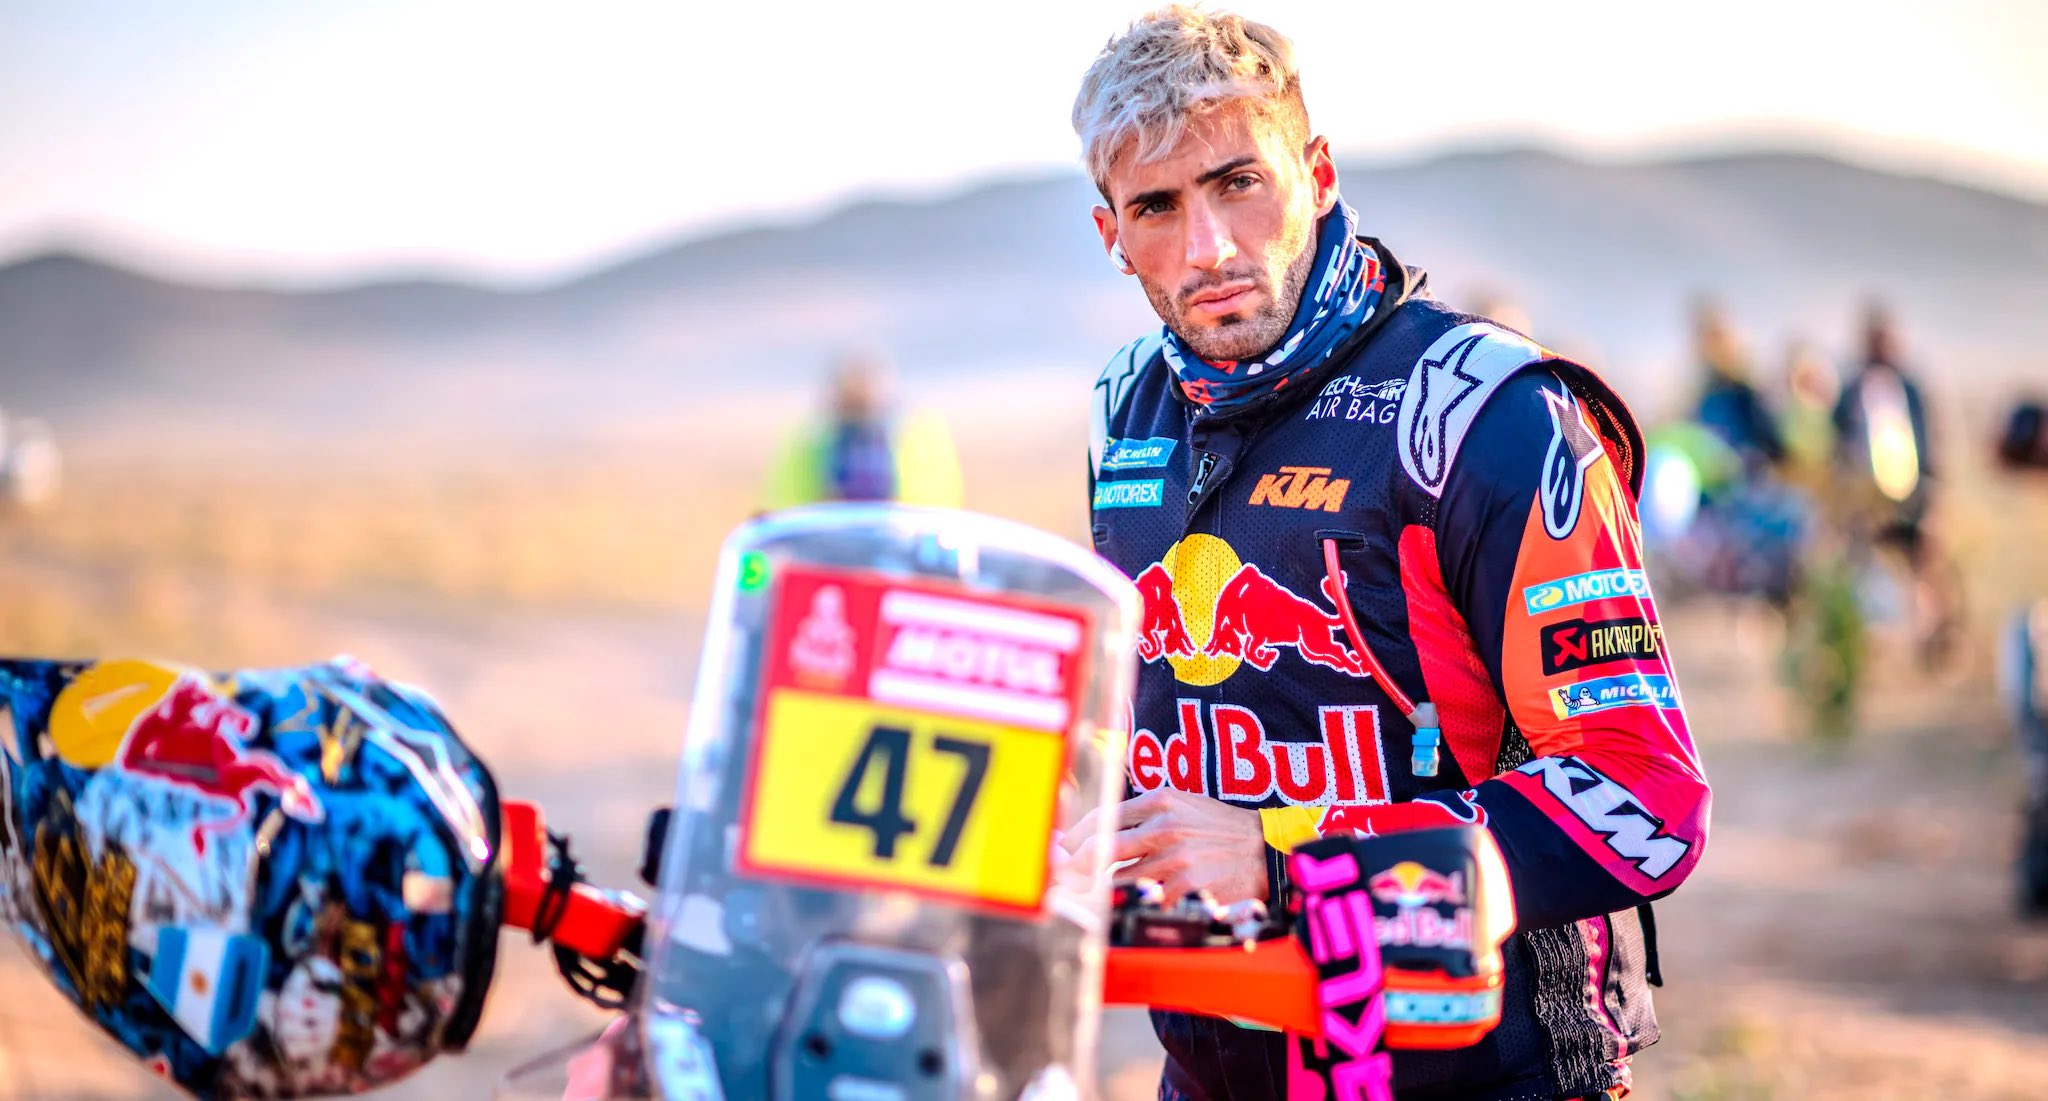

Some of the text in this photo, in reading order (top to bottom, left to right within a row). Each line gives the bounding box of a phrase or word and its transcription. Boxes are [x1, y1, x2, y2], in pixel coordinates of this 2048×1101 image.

[1305, 396, 1397, 424] AIR BAG
[1248, 465, 1351, 513] KTM
[886, 626, 1064, 694] MOTUL
[1125, 698, 1392, 806] ed Bull
[828, 724, 993, 868] 47
[1515, 755, 1692, 881] KTM
[1374, 903, 1412, 946] ed
